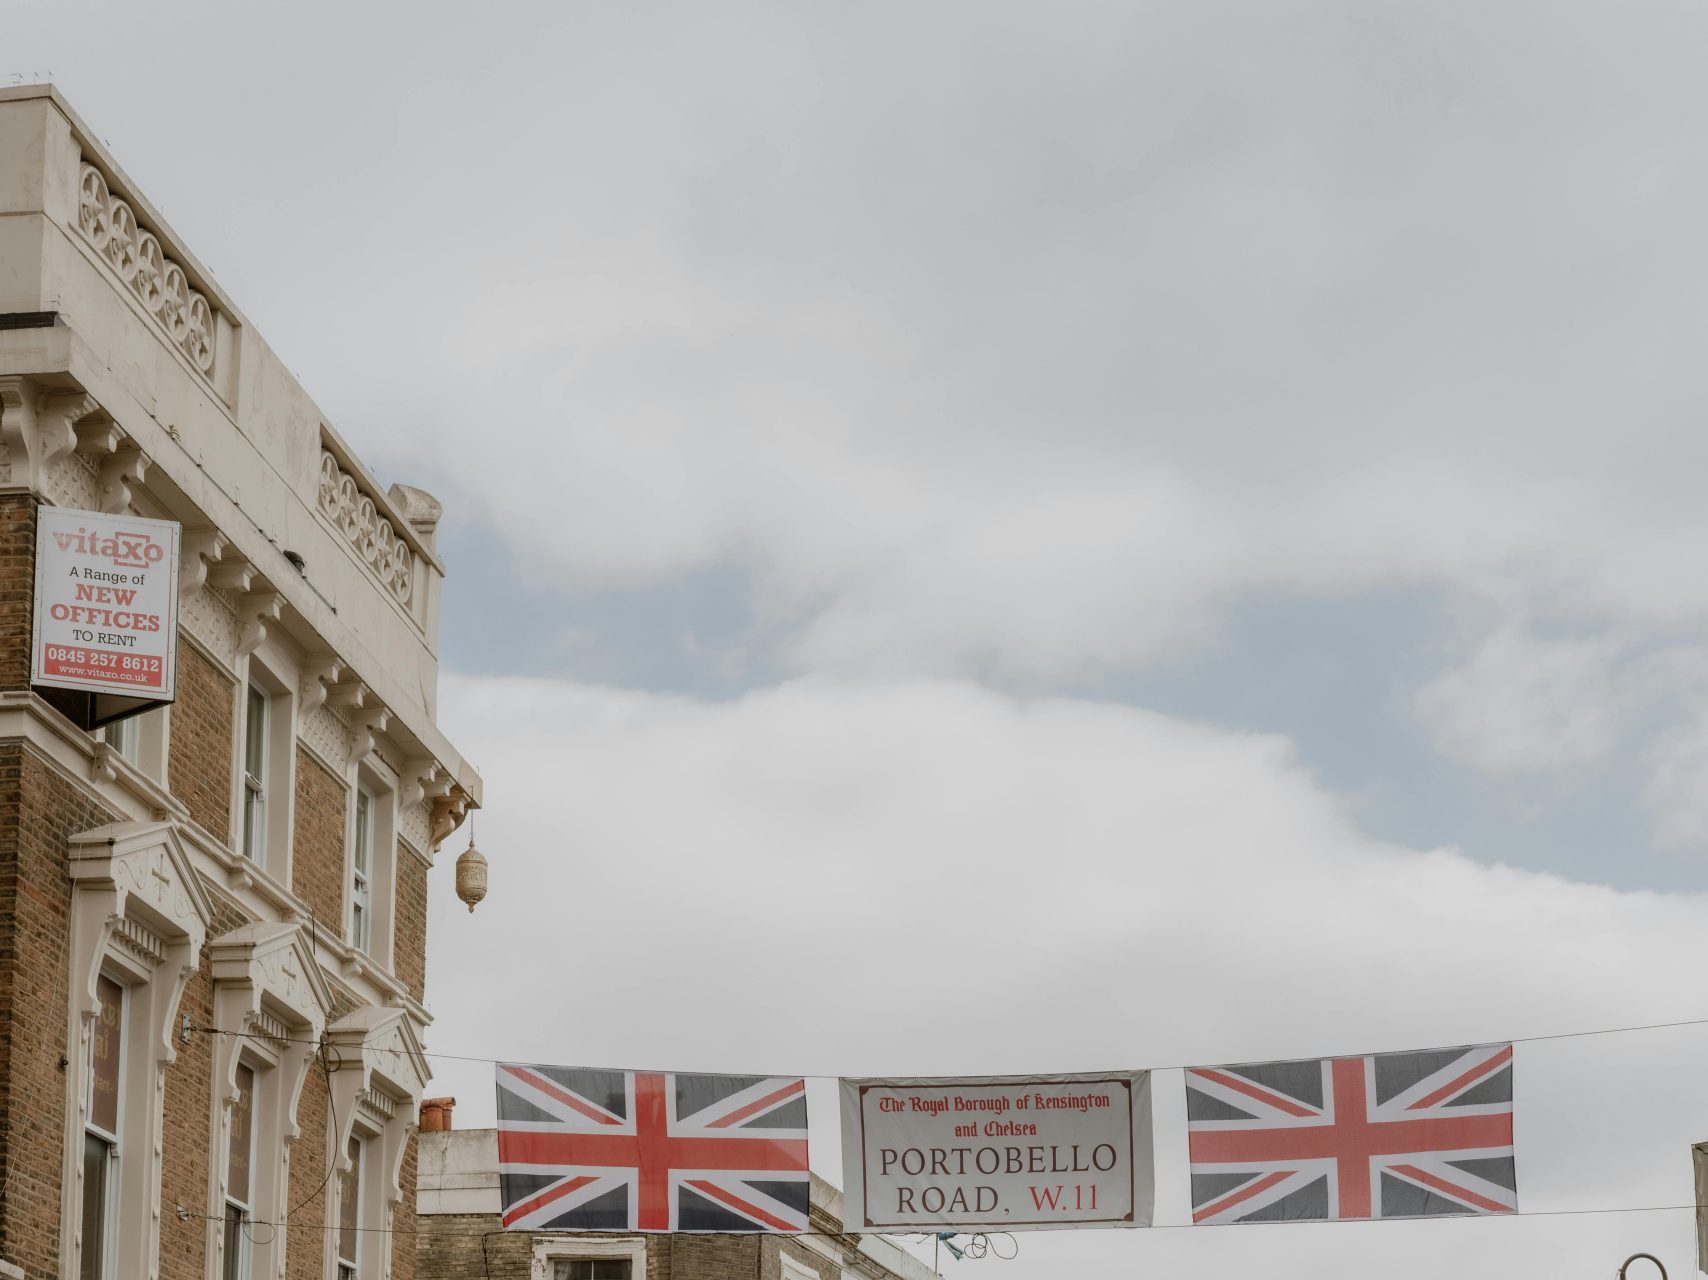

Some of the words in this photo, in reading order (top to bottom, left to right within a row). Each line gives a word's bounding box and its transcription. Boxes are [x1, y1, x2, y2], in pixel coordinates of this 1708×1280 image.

[53, 528, 163, 563] vitaxo
[69, 566, 79, 577] A
[84, 568, 127, 585] Range
[132, 574, 145, 585] of
[75, 583, 136, 606] NEW
[50, 603, 160, 632] OFFICES
[72, 629, 93, 642] TO
[97, 632, 136, 647] RENT
[48, 647, 85, 664] 0845
[90, 653, 117, 667] 257
[122, 656, 159, 672] 8612
[59, 665, 147, 682] www.vitaxo.co.uk
[879, 1097, 905, 1113] The
[908, 1096, 950, 1116] Royal
[954, 1096, 1011, 1115] Borough
[1016, 1094, 1030, 1111] of
[1034, 1093, 1111, 1113] Kensington
[955, 1122, 977, 1137] and
[984, 1121, 1036, 1137] Chelsea
[880, 1144, 1117, 1175] PORTOBELLO
[896, 1185, 1010, 1215] ROAD,
